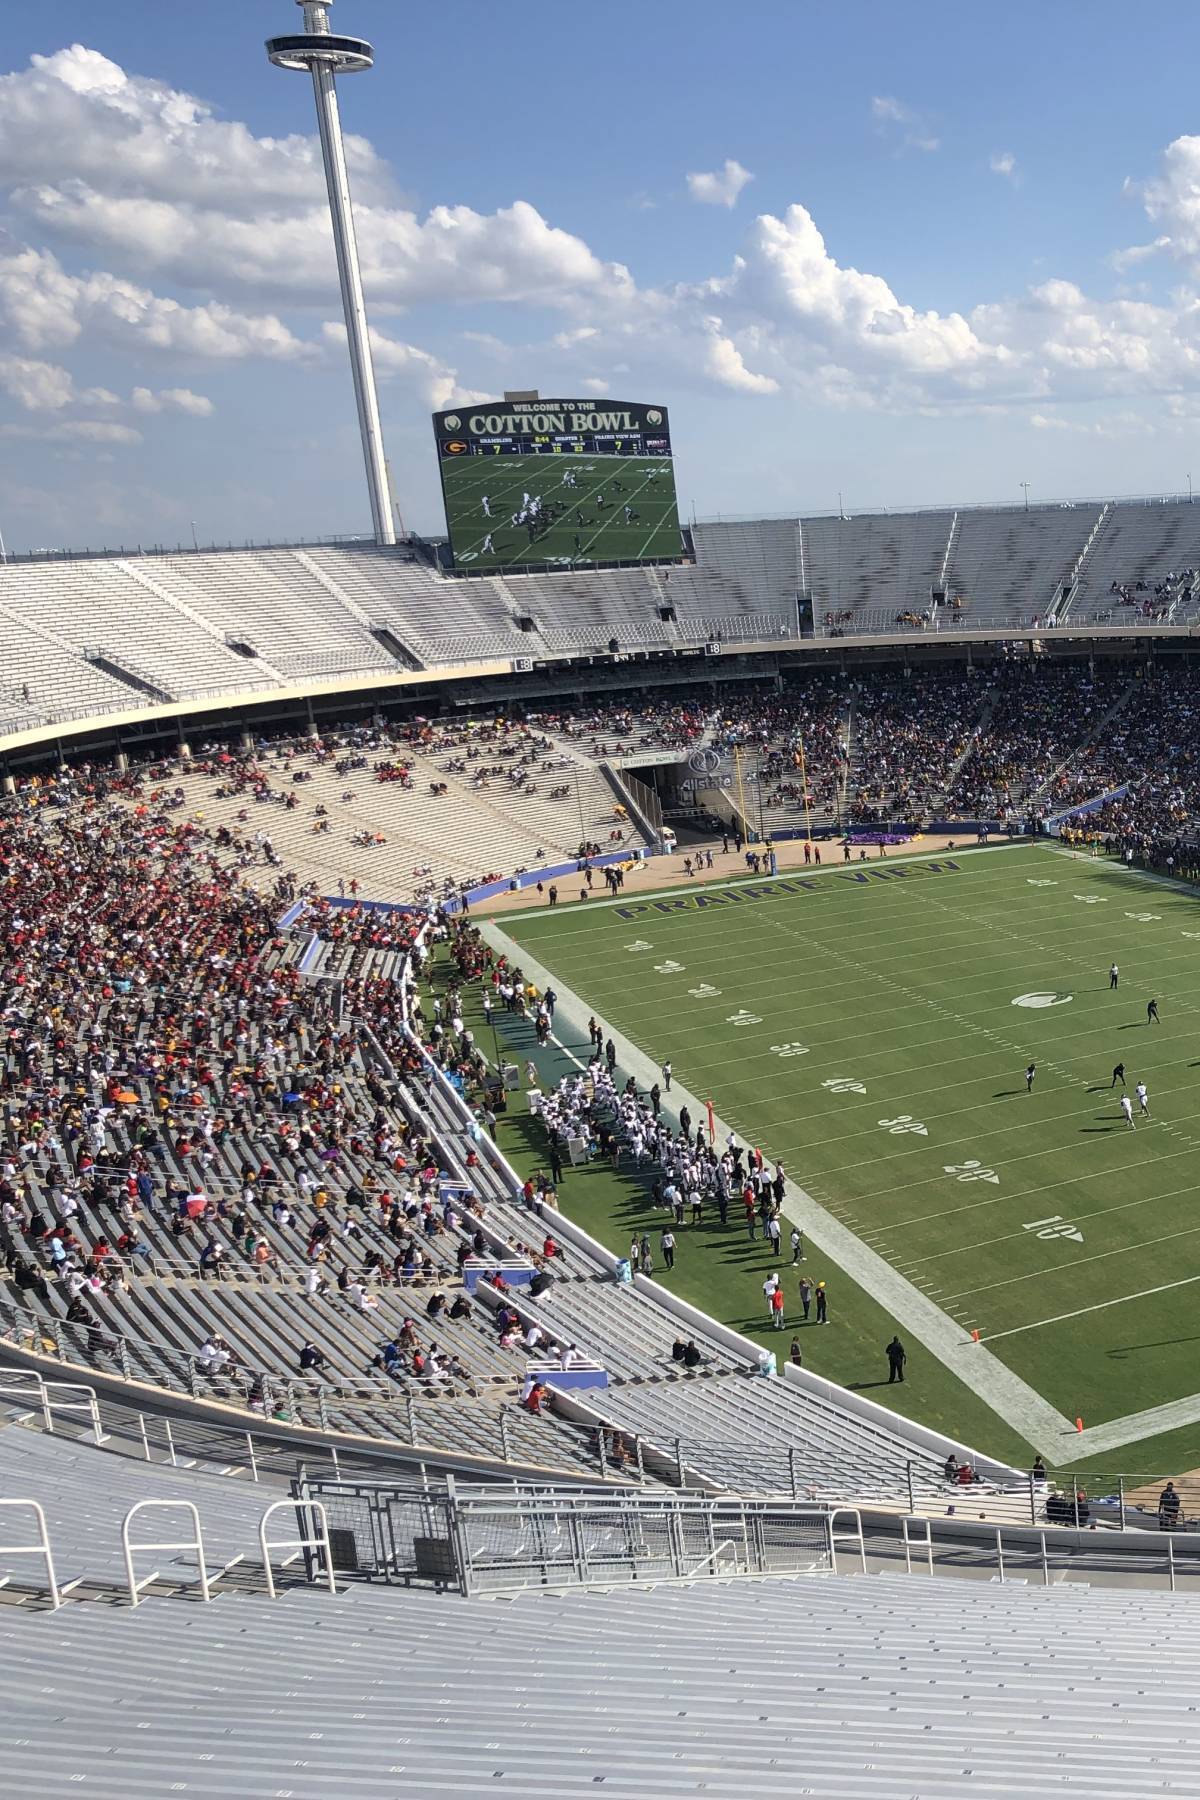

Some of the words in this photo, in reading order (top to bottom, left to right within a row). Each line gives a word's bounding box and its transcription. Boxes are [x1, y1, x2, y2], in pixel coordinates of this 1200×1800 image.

[513, 403, 561, 412] WELCOME
[563, 403, 575, 411] TO
[577, 402, 596, 411] THE
[469, 413, 566, 435] COTTON
[571, 411, 640, 433] BOWL
[681, 776, 732, 790] Allstate
[614, 879, 834, 920] PRAIRIE
[838, 859, 963, 884] VIEW
[687, 985, 722, 999] 30
[725, 1012, 763, 1026] 40
[769, 1042, 810, 1057] 50
[821, 1077, 862, 1094] 40
[877, 1115, 923, 1134] 30
[942, 1160, 995, 1183] 20
[1022, 1215, 1077, 1240] 10
